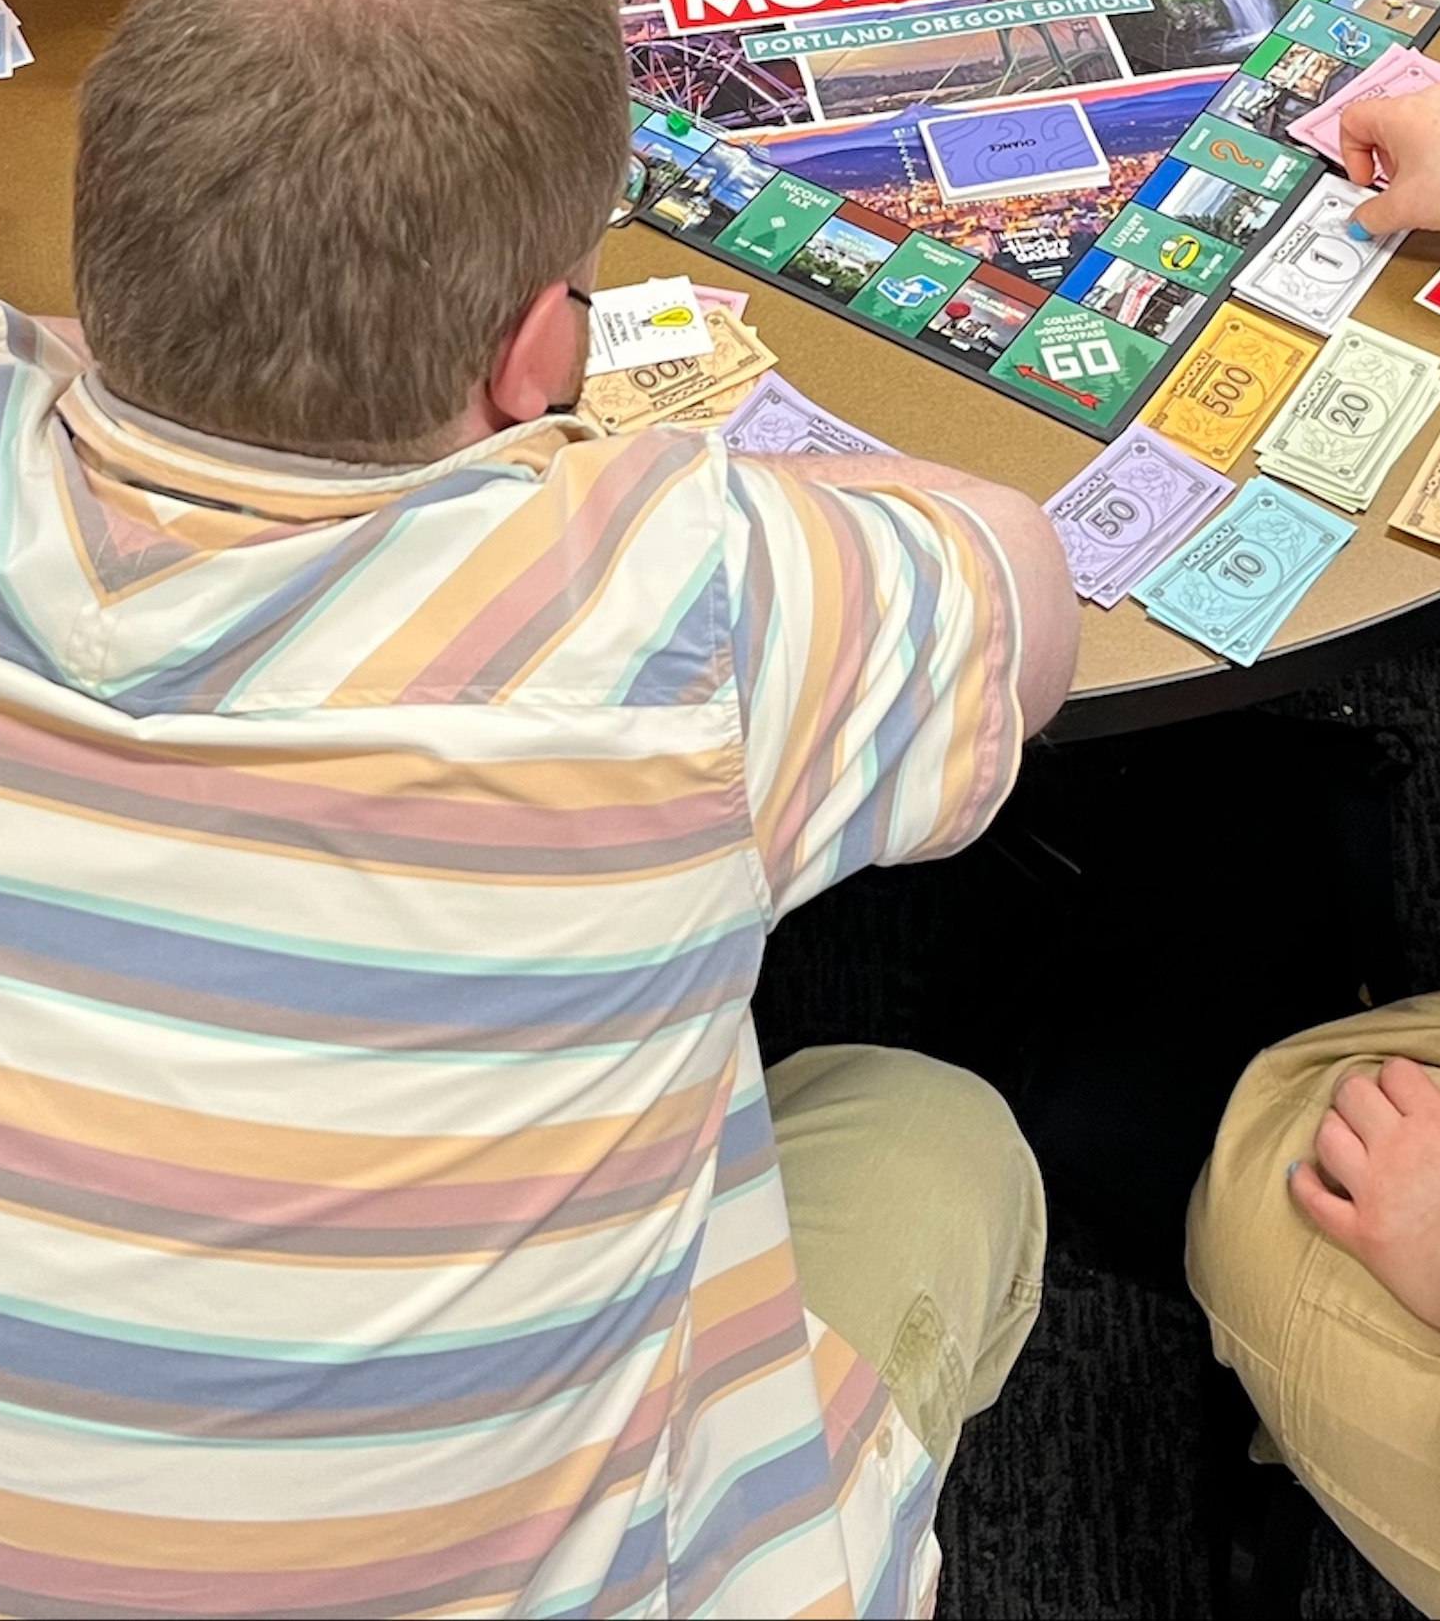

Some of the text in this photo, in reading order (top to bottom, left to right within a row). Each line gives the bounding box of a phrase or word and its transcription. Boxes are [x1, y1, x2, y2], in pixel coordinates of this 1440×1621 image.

[752, 22, 905, 56] PORTLAND,
[911, 3, 1025, 36] OREGON
[989, 138, 1038, 153] CHANCE
[779, 180, 831, 209] INCOME
[786, 192, 812, 210] TAX
[1111, 212, 1145, 248] LUXURY
[1128, 225, 1152, 245] TAX
[1311, 249, 1343, 269] 1
[1042, 311, 1089, 326] COLLECT
[1055, 331, 1080, 343] YOU
[1080, 327, 1107, 340] PASS
[1065, 319, 1105, 333] SALARY
[633, 358, 696, 390] 100
[1040, 338, 1121, 381] GO
[1171, 349, 1212, 397] MONOPOLY
[652, 376, 718, 410] MONOPOLY
[1200, 365, 1253, 417] 500
[1293, 369, 1333, 419] MONOPOLY
[1329, 392, 1370, 430] 20
[1053, 470, 1108, 518] MONOPOLY
[1090, 498, 1137, 538] 50
[1181, 522, 1235, 569] MONOPOLY
[1220, 552, 1264, 588] 10
